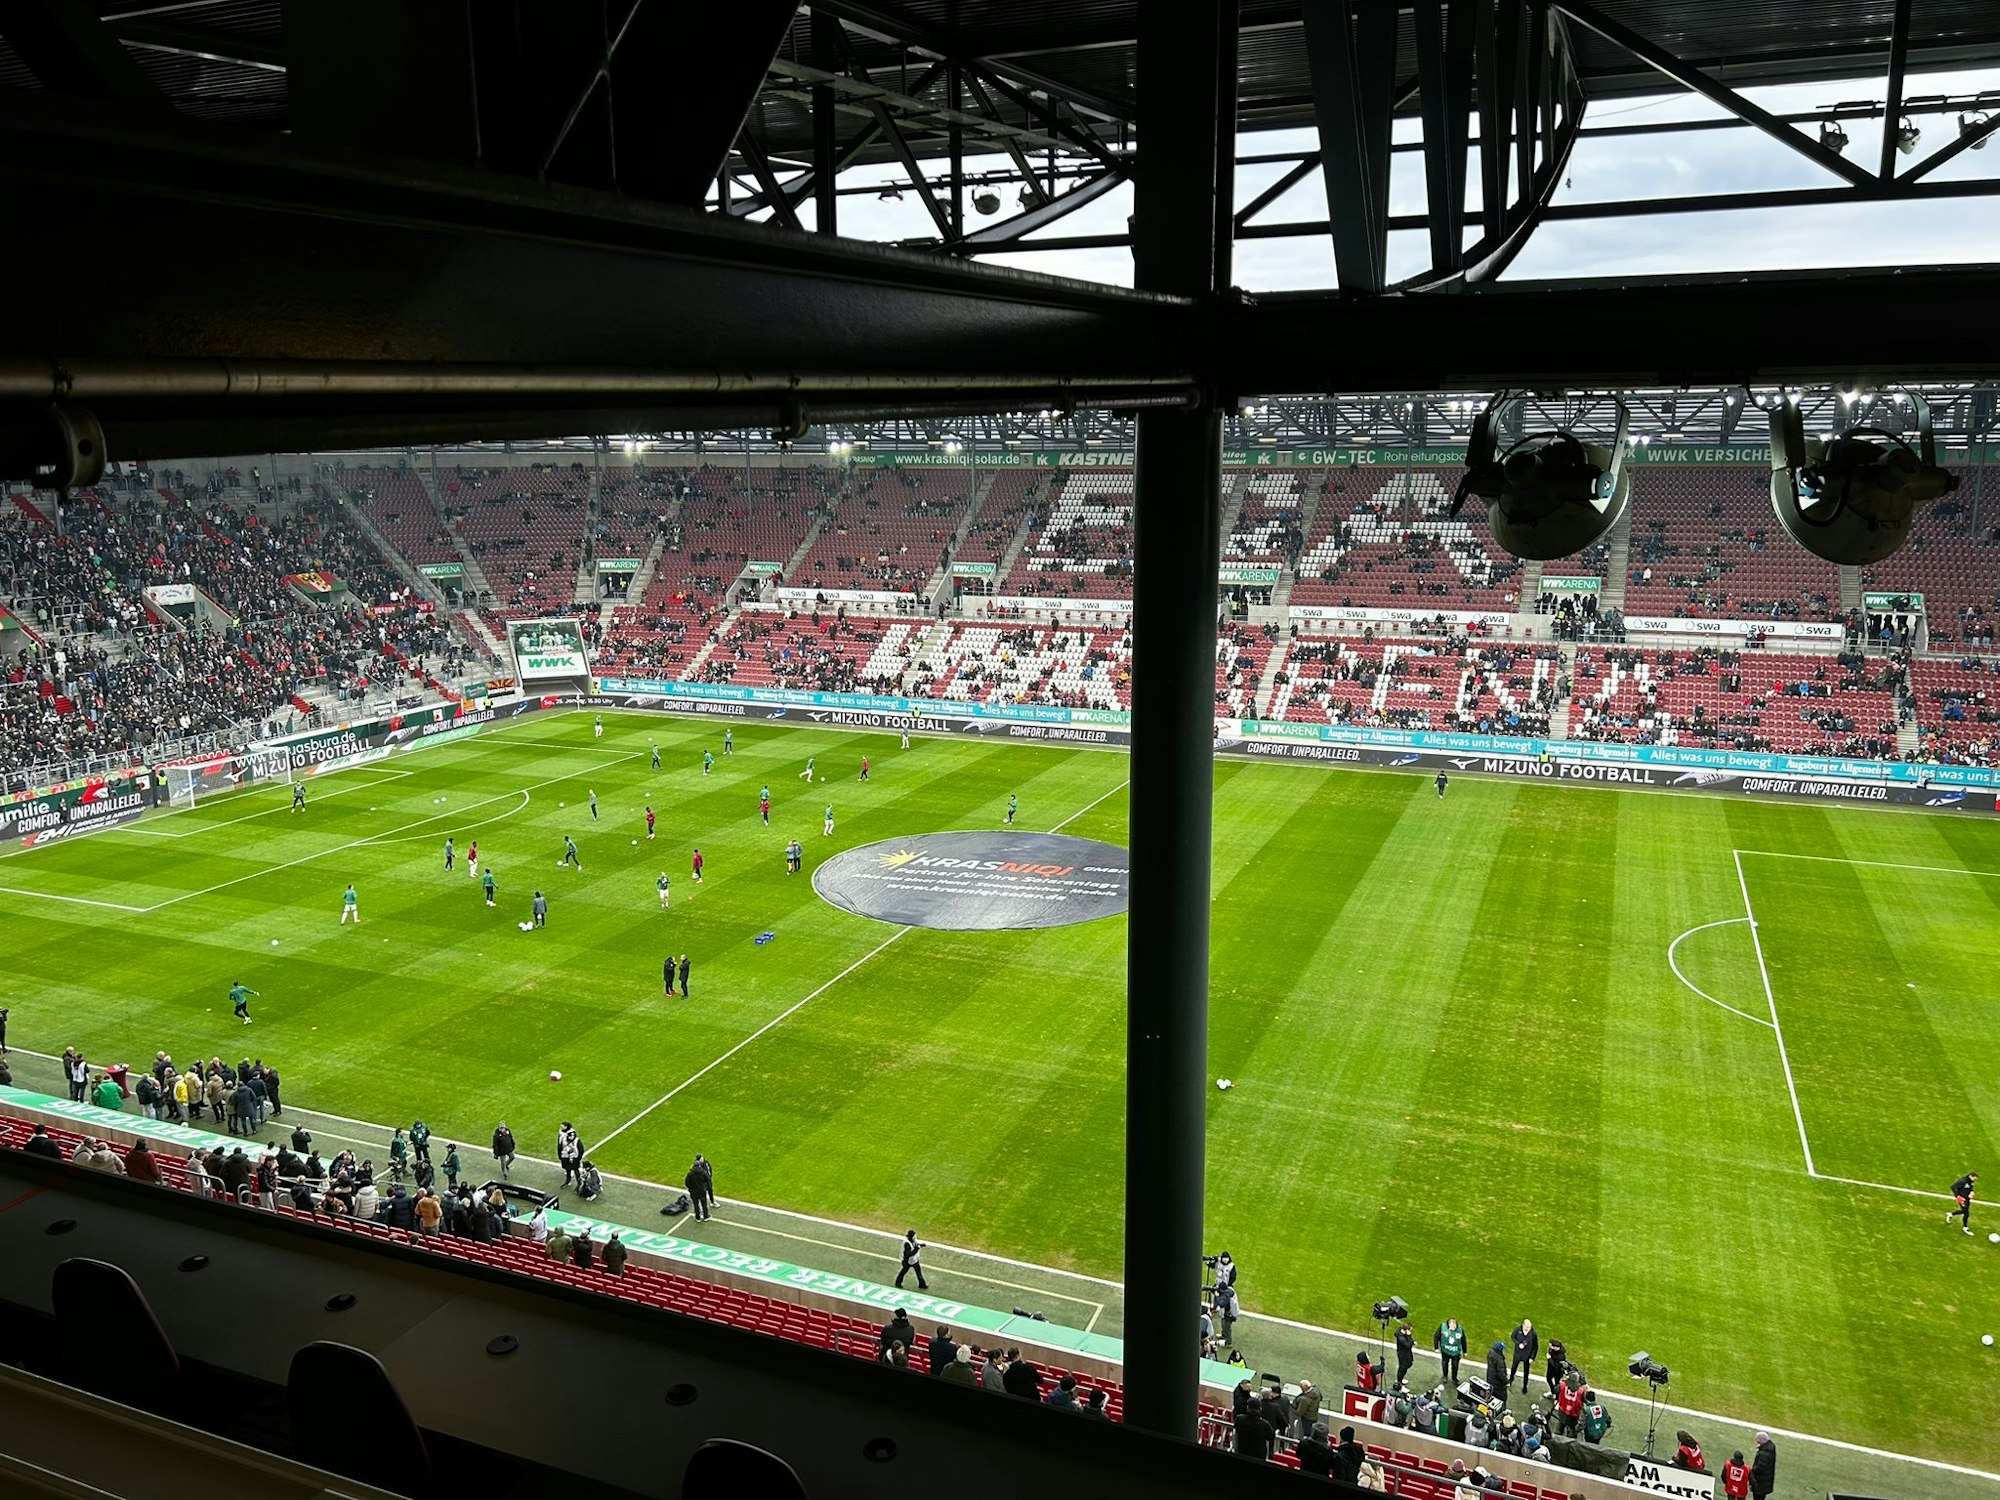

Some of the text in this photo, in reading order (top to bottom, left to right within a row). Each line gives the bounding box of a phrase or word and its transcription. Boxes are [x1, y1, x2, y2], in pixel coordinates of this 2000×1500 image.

[895, 452, 1020, 466] www.krasniqi-solar.de
[1648, 449, 1688, 462] WWK
[599, 561, 638, 569] WWKARENA
[953, 565, 992, 574] WWKARENA
[1219, 571, 1276, 581] WWKARENA
[1542, 579, 1598, 589] WWKARENA
[1302, 609, 1322, 617] swa
[1483, 615, 1504, 623] swa
[1644, 621, 1832, 635] swa swa swa swa
[528, 657, 575, 668] WWK
[673, 684, 688, 692] Alles
[719, 687, 745, 698] bewegt
[663, 700, 745, 715] COMFORT. UNPARALLELED.
[822, 694, 840, 703] Alles
[857, 698, 870, 706] uns
[872, 697, 900, 709] bewegt
[982, 707, 1066, 720] Alles was uns bewegt
[1071, 711, 1123, 724] WWKARENA
[423, 721, 452, 735] COMFORT.
[832, 712, 950, 731] MIZUNO FOOTBALL
[1049, 727, 1107, 743] UNPARALLELED.
[1261, 724, 1319, 737] WWKARENA
[1422, 735, 1532, 751] Alles was uns bewegt
[310, 738, 373, 764] FOOTBALL
[1247, 743, 1361, 761] COMFORT. UNPARALLELED.
[1650, 750, 1772, 769] Alles was uns bewegt
[1785, 759, 1838, 773] Augsburger
[1484, 759, 1655, 784] MIZUNO FOOTBALL
[1904, 766, 1935, 778] Alles
[1938, 771, 1964, 780] was
[1967, 772, 1990, 782] uns
[1742, 778, 1888, 800] COMFORT. UNPARALLELED.
[70, 793, 144, 820] UNPARALLELED.
[910, 857, 1074, 877] KRASNIQI
[894, 868, 956, 879] Partner
[1022, 876, 1121, 889] Solaranlage
[560, 1216, 968, 1319] DEHNER RECYCLING
